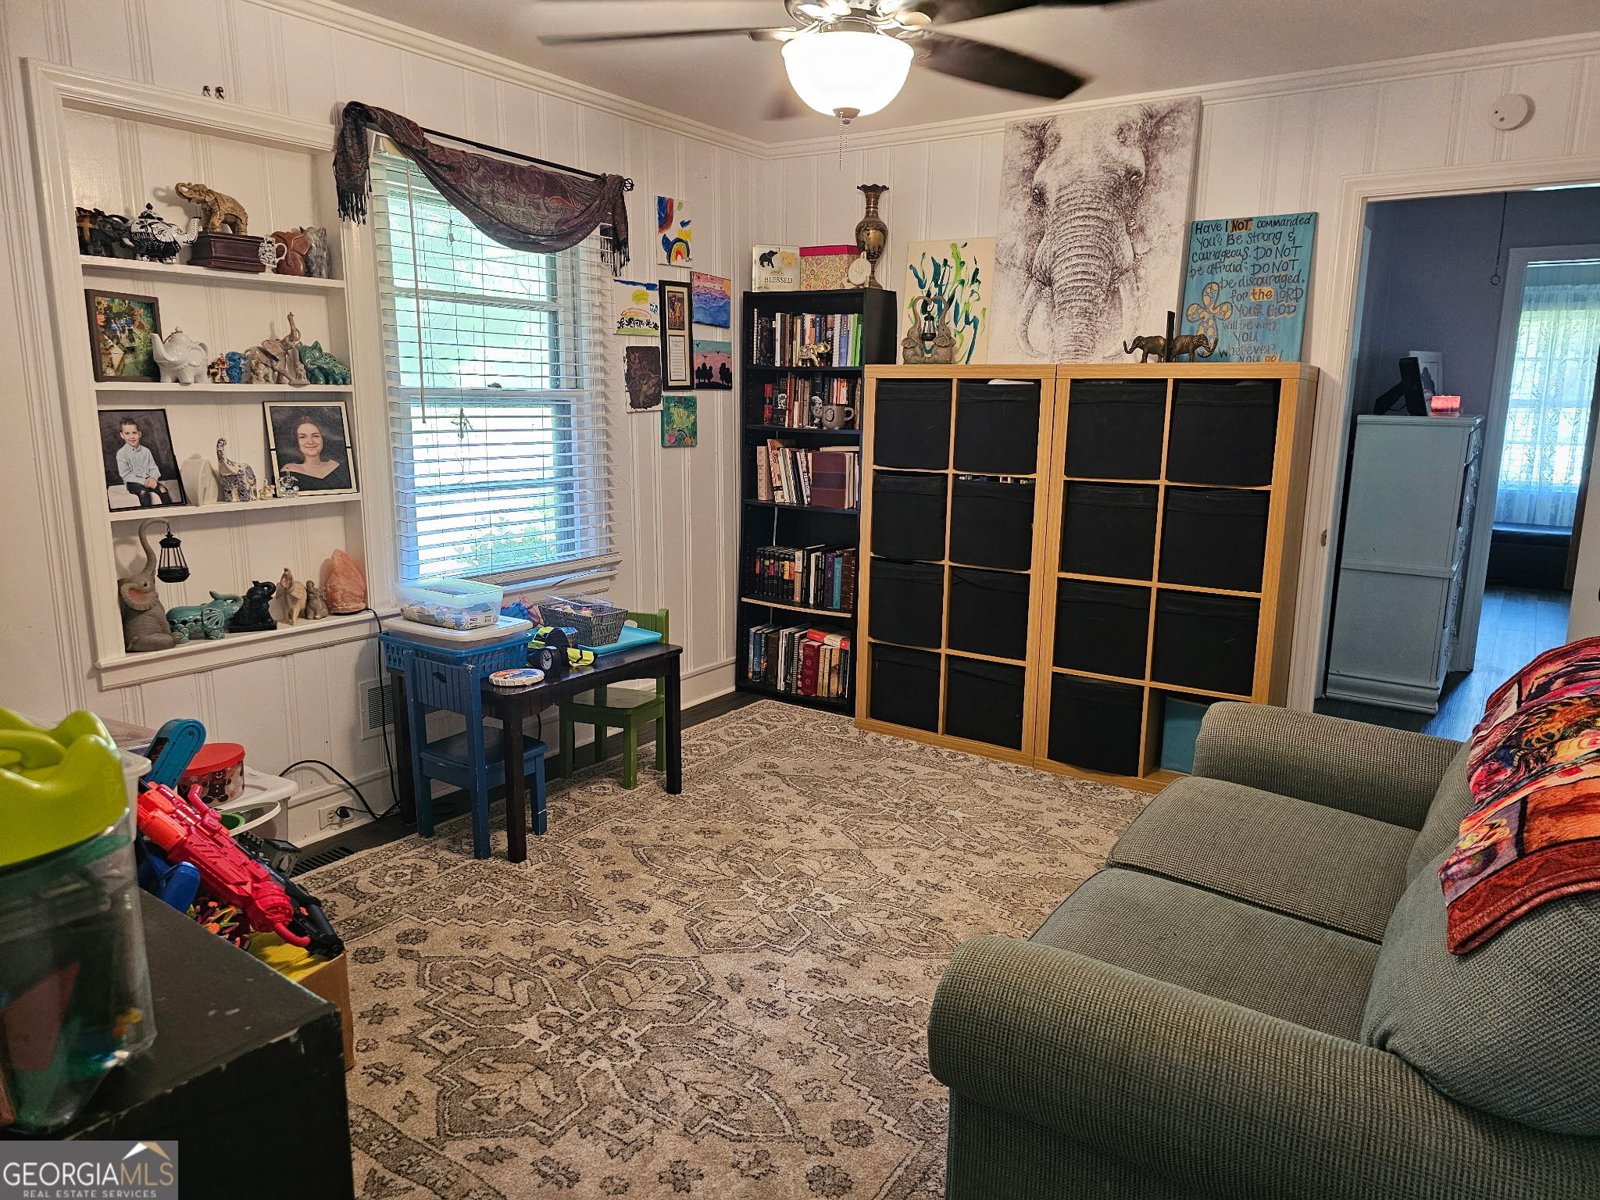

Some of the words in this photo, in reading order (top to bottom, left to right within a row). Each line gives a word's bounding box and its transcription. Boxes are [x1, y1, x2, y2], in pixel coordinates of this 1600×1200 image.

[1195, 223, 1223, 235] Have
[1225, 220, 1229, 232] I
[1231, 219, 1253, 232] NOT
[1275, 245, 1303, 260] NOT
[1189, 264, 1205, 279] be
[764, 276, 793, 284] BLESSED
[1220, 276, 1237, 290] be
[1250, 288, 1273, 301] the
[1267, 303, 1297, 317] GOD
